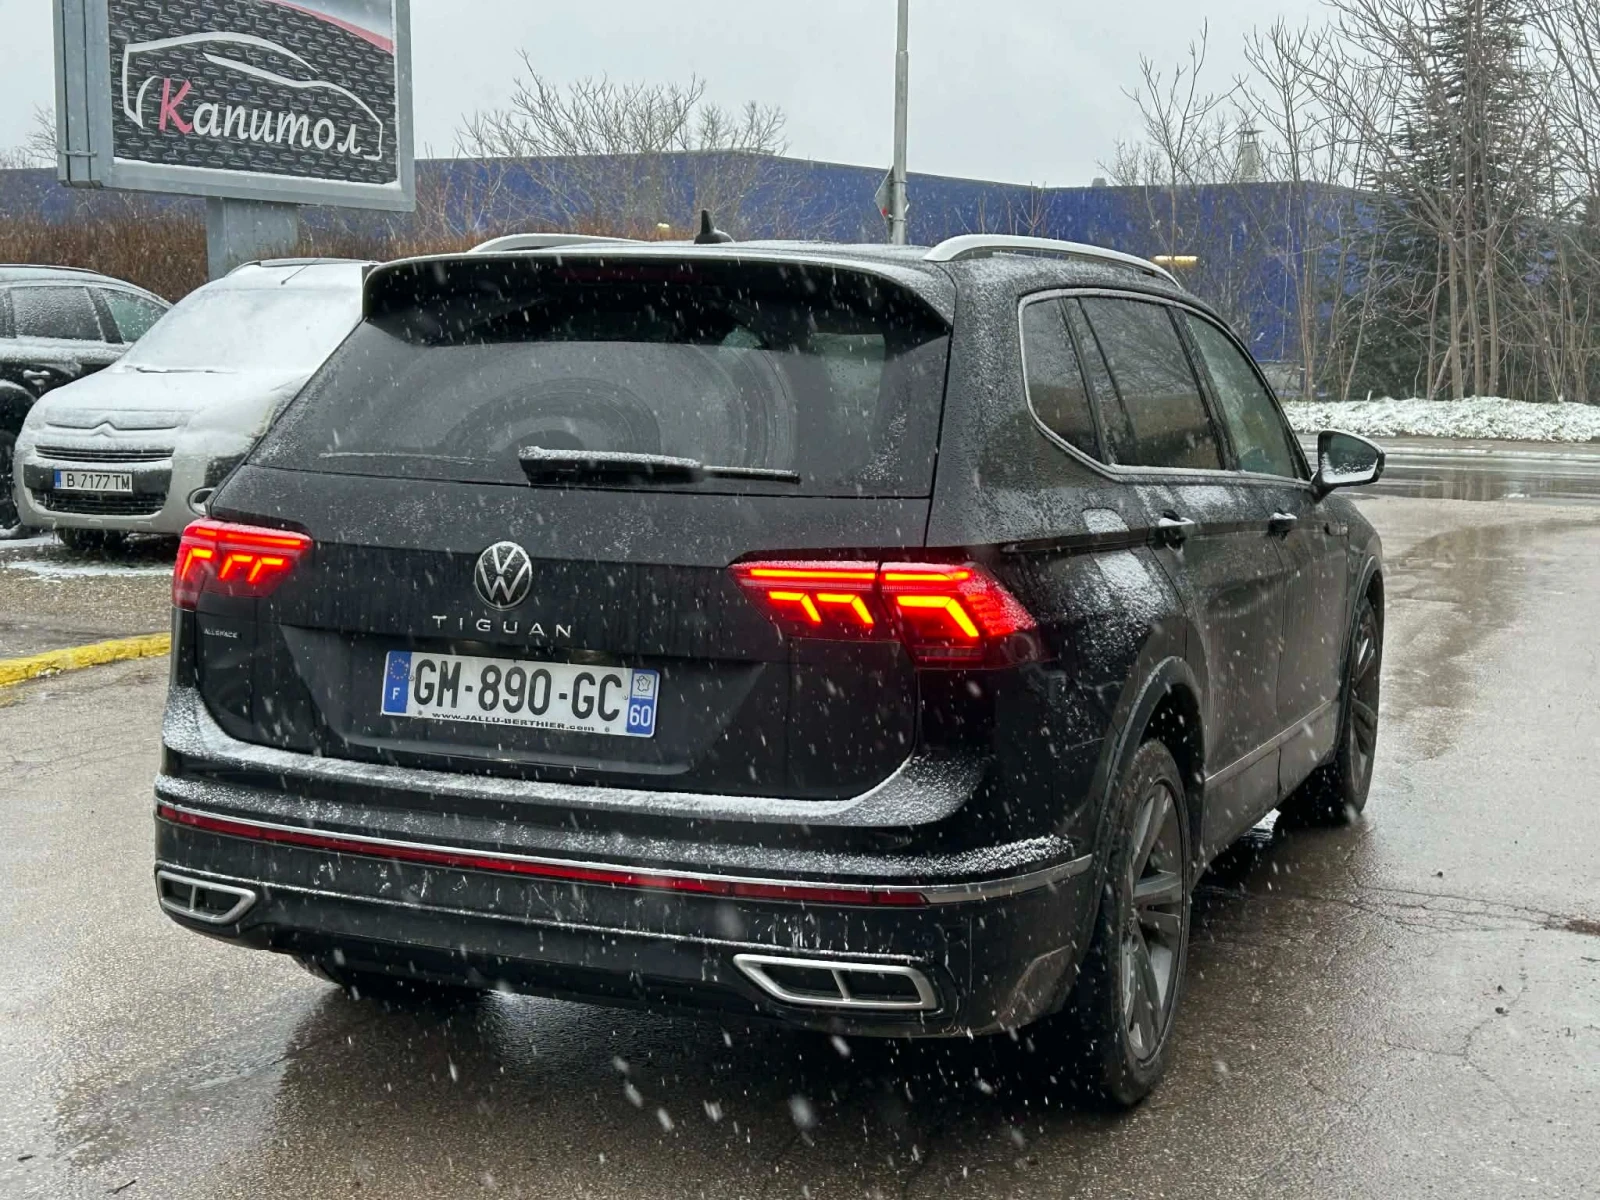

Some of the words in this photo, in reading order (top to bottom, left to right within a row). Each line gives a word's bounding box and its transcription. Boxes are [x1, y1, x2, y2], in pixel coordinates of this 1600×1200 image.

[66, 473, 76, 488] B
[81, 473, 111, 489] 7177
[113, 474, 130, 490] TM
[431, 615, 572, 639] TIGUAN
[391, 687, 401, 701] F
[413, 658, 623, 722] GM-890-GC
[431, 712, 595, 732] www.JALLU-BERTHIER.com
[629, 703, 652, 727] 60
